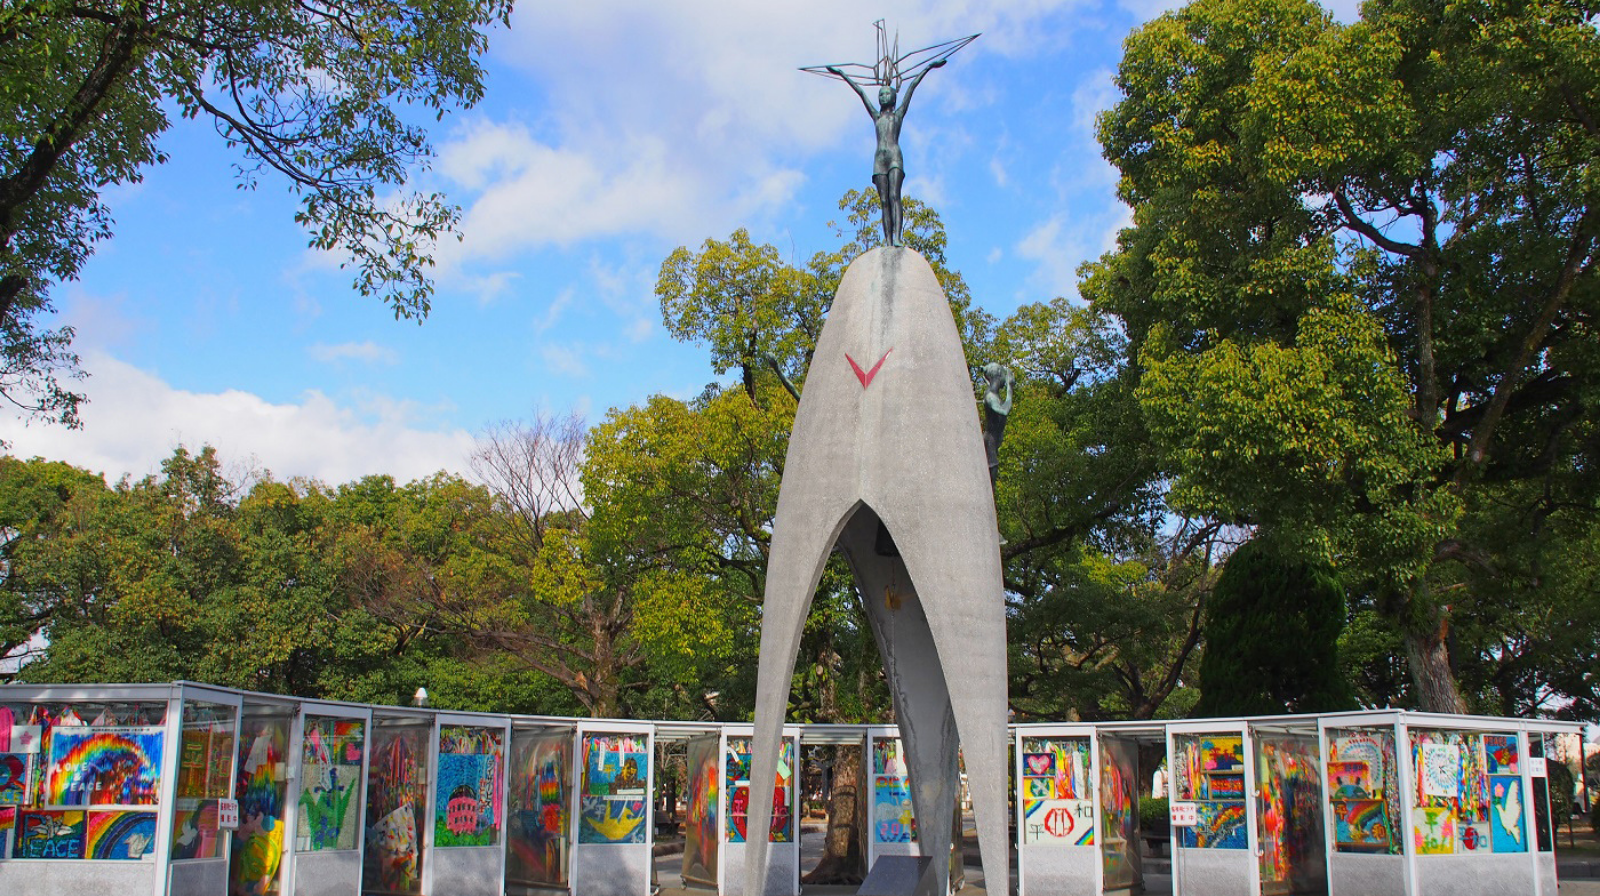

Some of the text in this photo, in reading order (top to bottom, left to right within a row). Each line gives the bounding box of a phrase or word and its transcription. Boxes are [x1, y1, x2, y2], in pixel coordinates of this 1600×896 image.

[55, 761, 88, 773] LOVE
[62, 781, 103, 793] PEACE
[23, 814, 80, 858] PEACE
